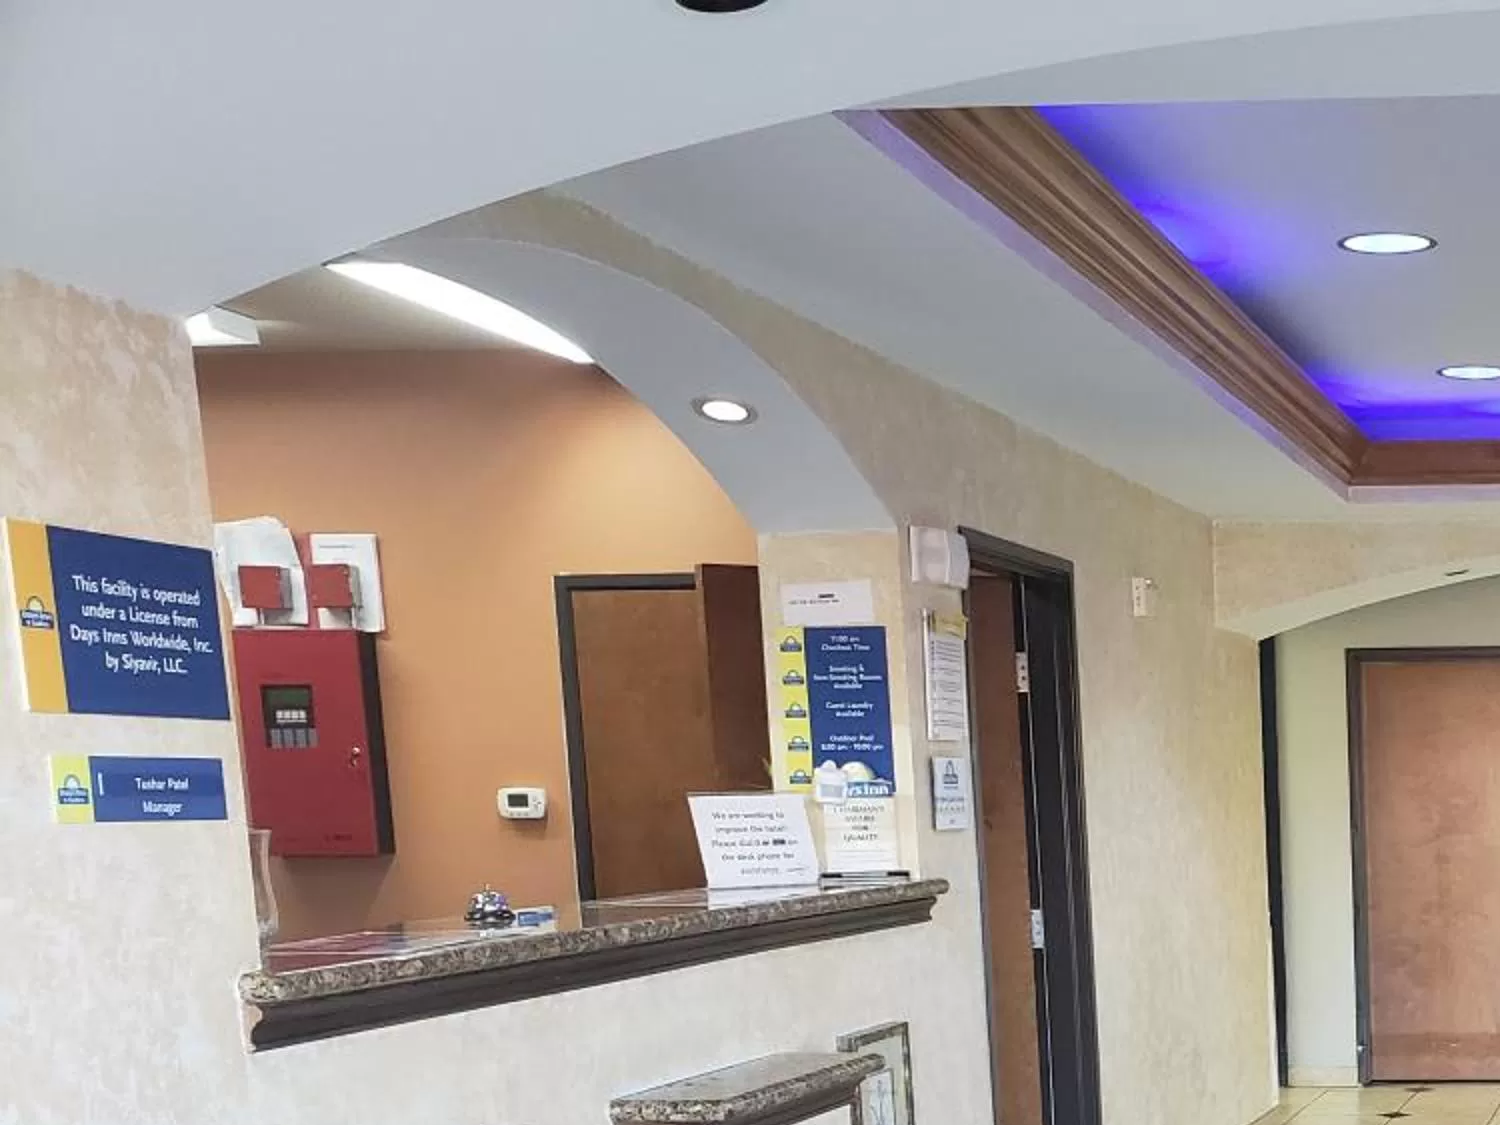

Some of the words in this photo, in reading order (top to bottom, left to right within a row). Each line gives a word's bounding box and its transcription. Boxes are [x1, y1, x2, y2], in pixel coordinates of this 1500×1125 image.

[72, 574, 99, 594] This
[101, 578, 139, 602] facility
[141, 585, 150, 600] is
[153, 587, 201, 606] operated
[82, 603, 116, 621] under
[119, 609, 126, 621] a
[129, 605, 171, 625] License
[173, 612, 199, 629] from
[70, 624, 100, 646] Days
[103, 629, 128, 645] Inns
[130, 630, 192, 653] Worldwide,
[193, 638, 214, 653] Inc.
[105, 651, 120, 671] by
[143, 801, 183, 816] Manager
